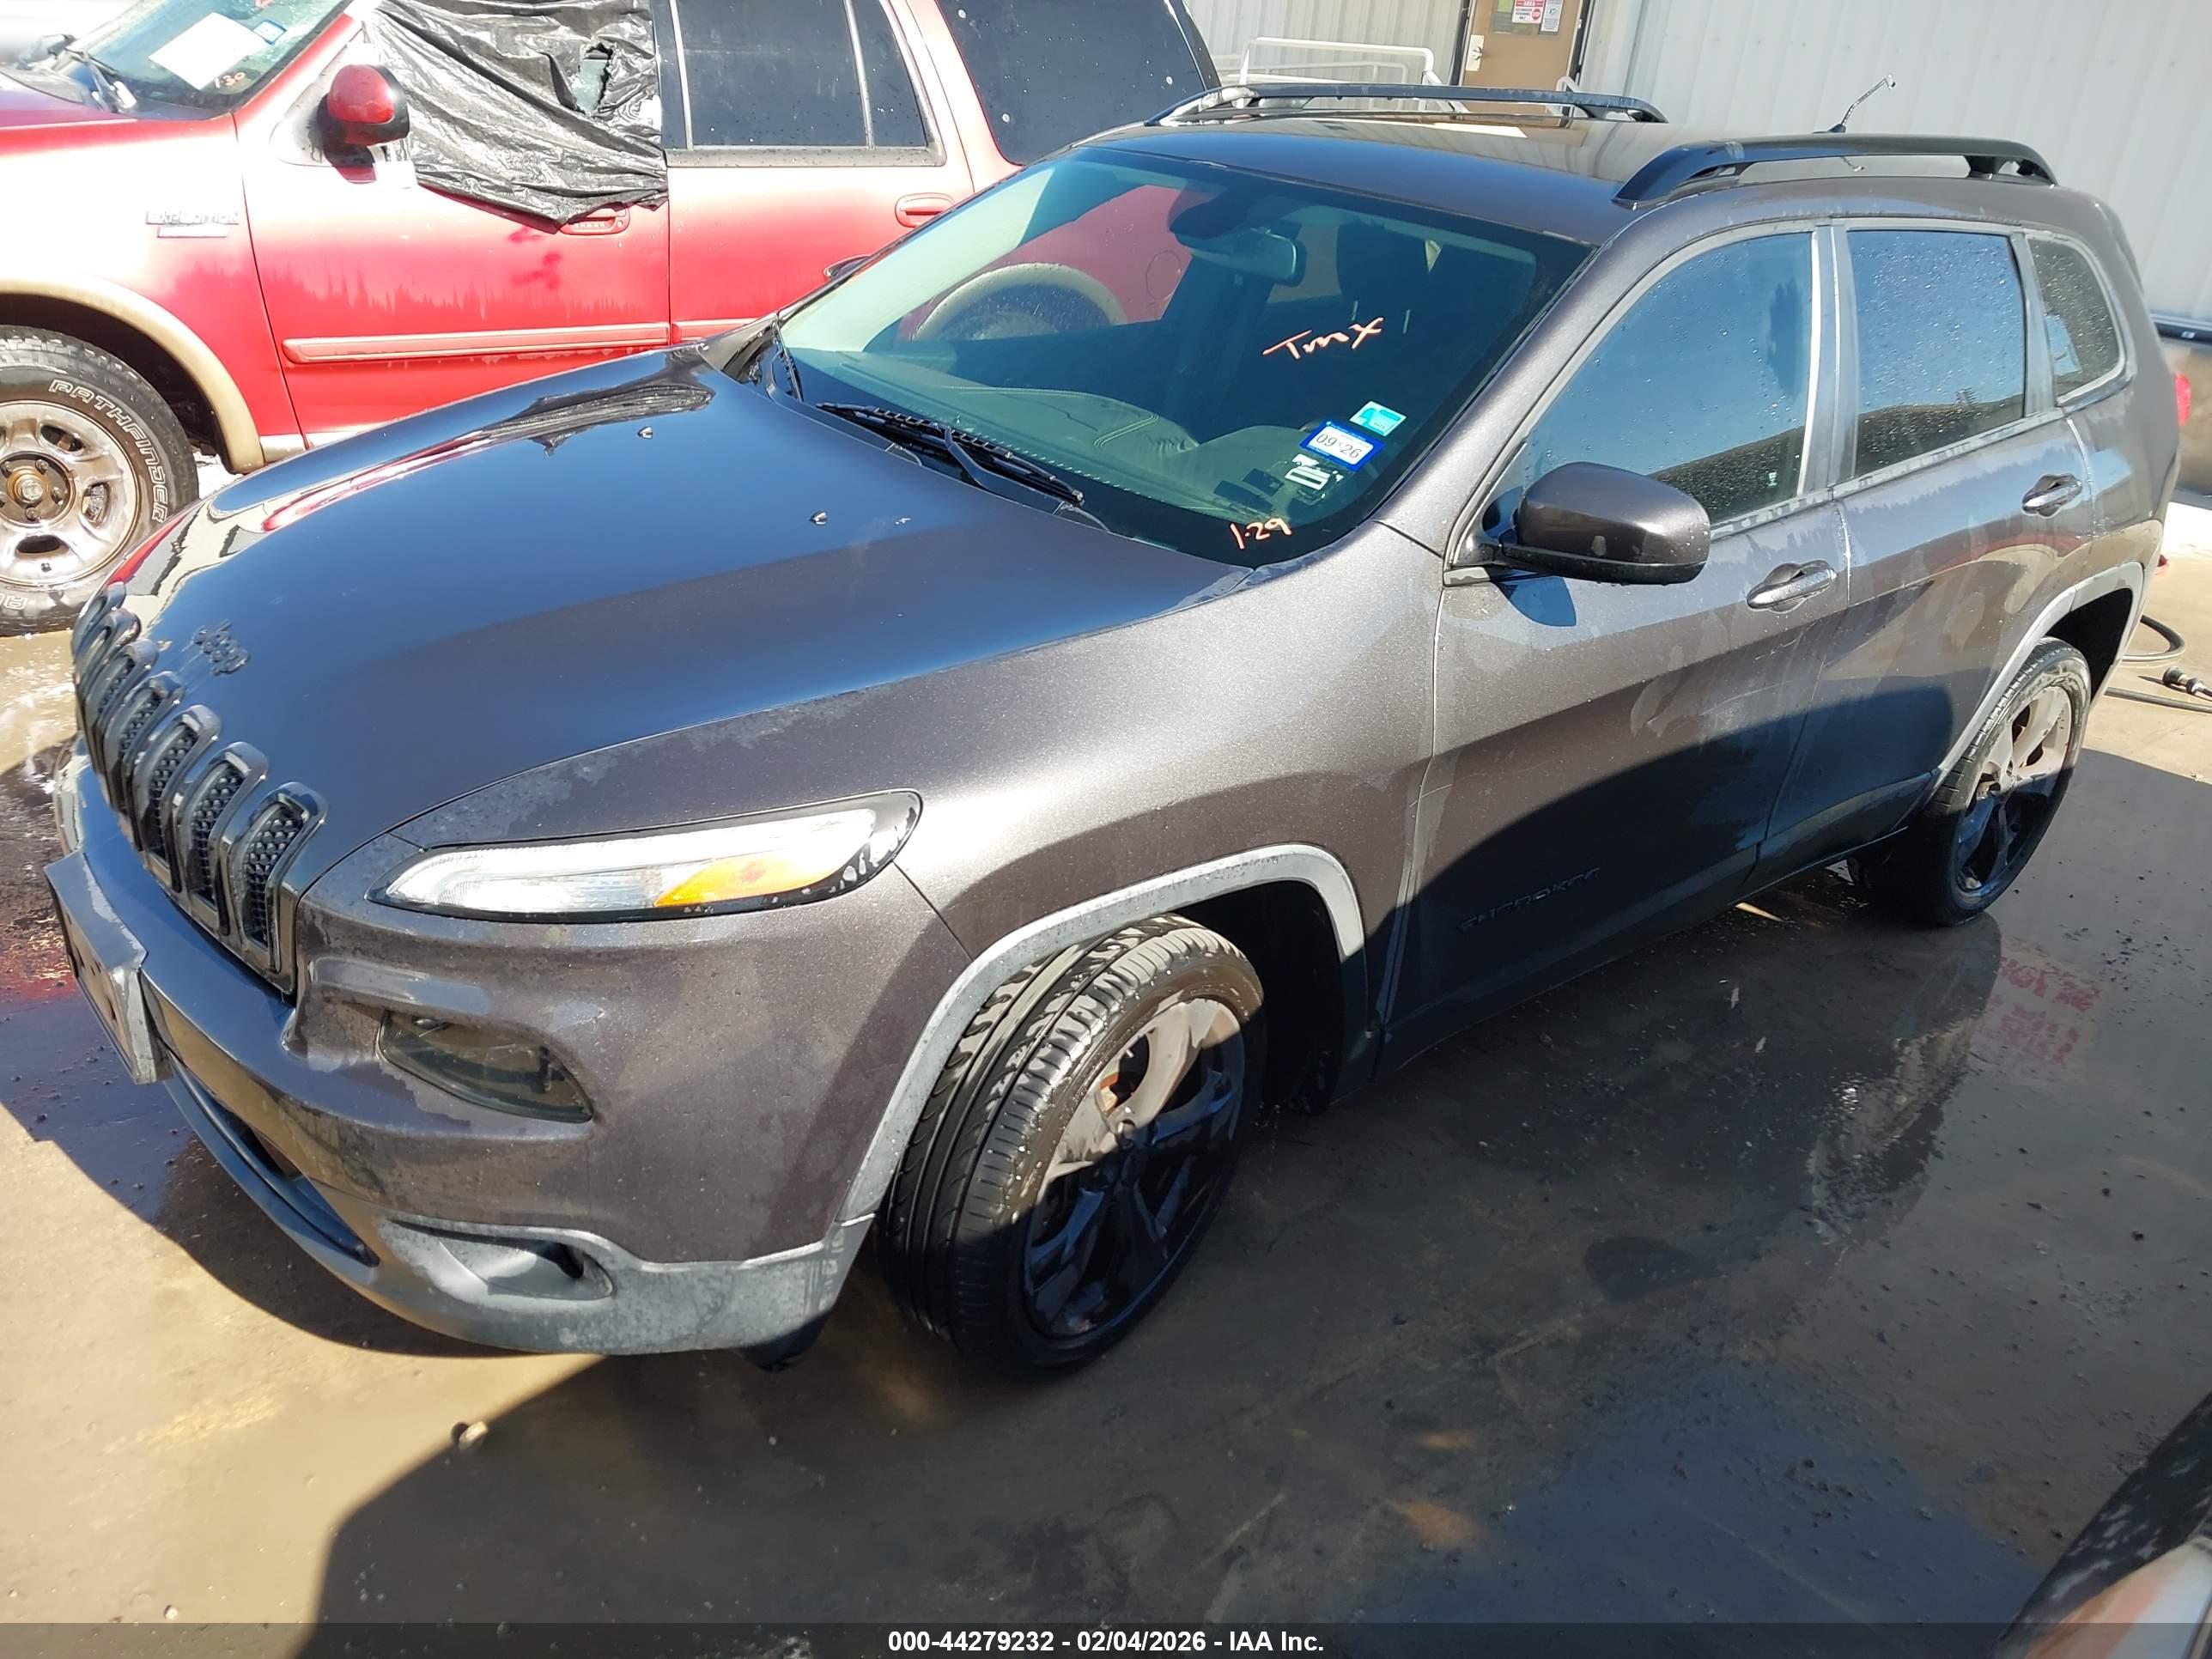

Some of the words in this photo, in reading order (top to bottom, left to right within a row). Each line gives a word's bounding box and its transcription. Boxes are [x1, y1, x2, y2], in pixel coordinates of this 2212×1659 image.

[48, 379, 168, 524] PATHFINDER
[1316, 433, 1338, 447] 09
[1340, 443, 1363, 459] 26
